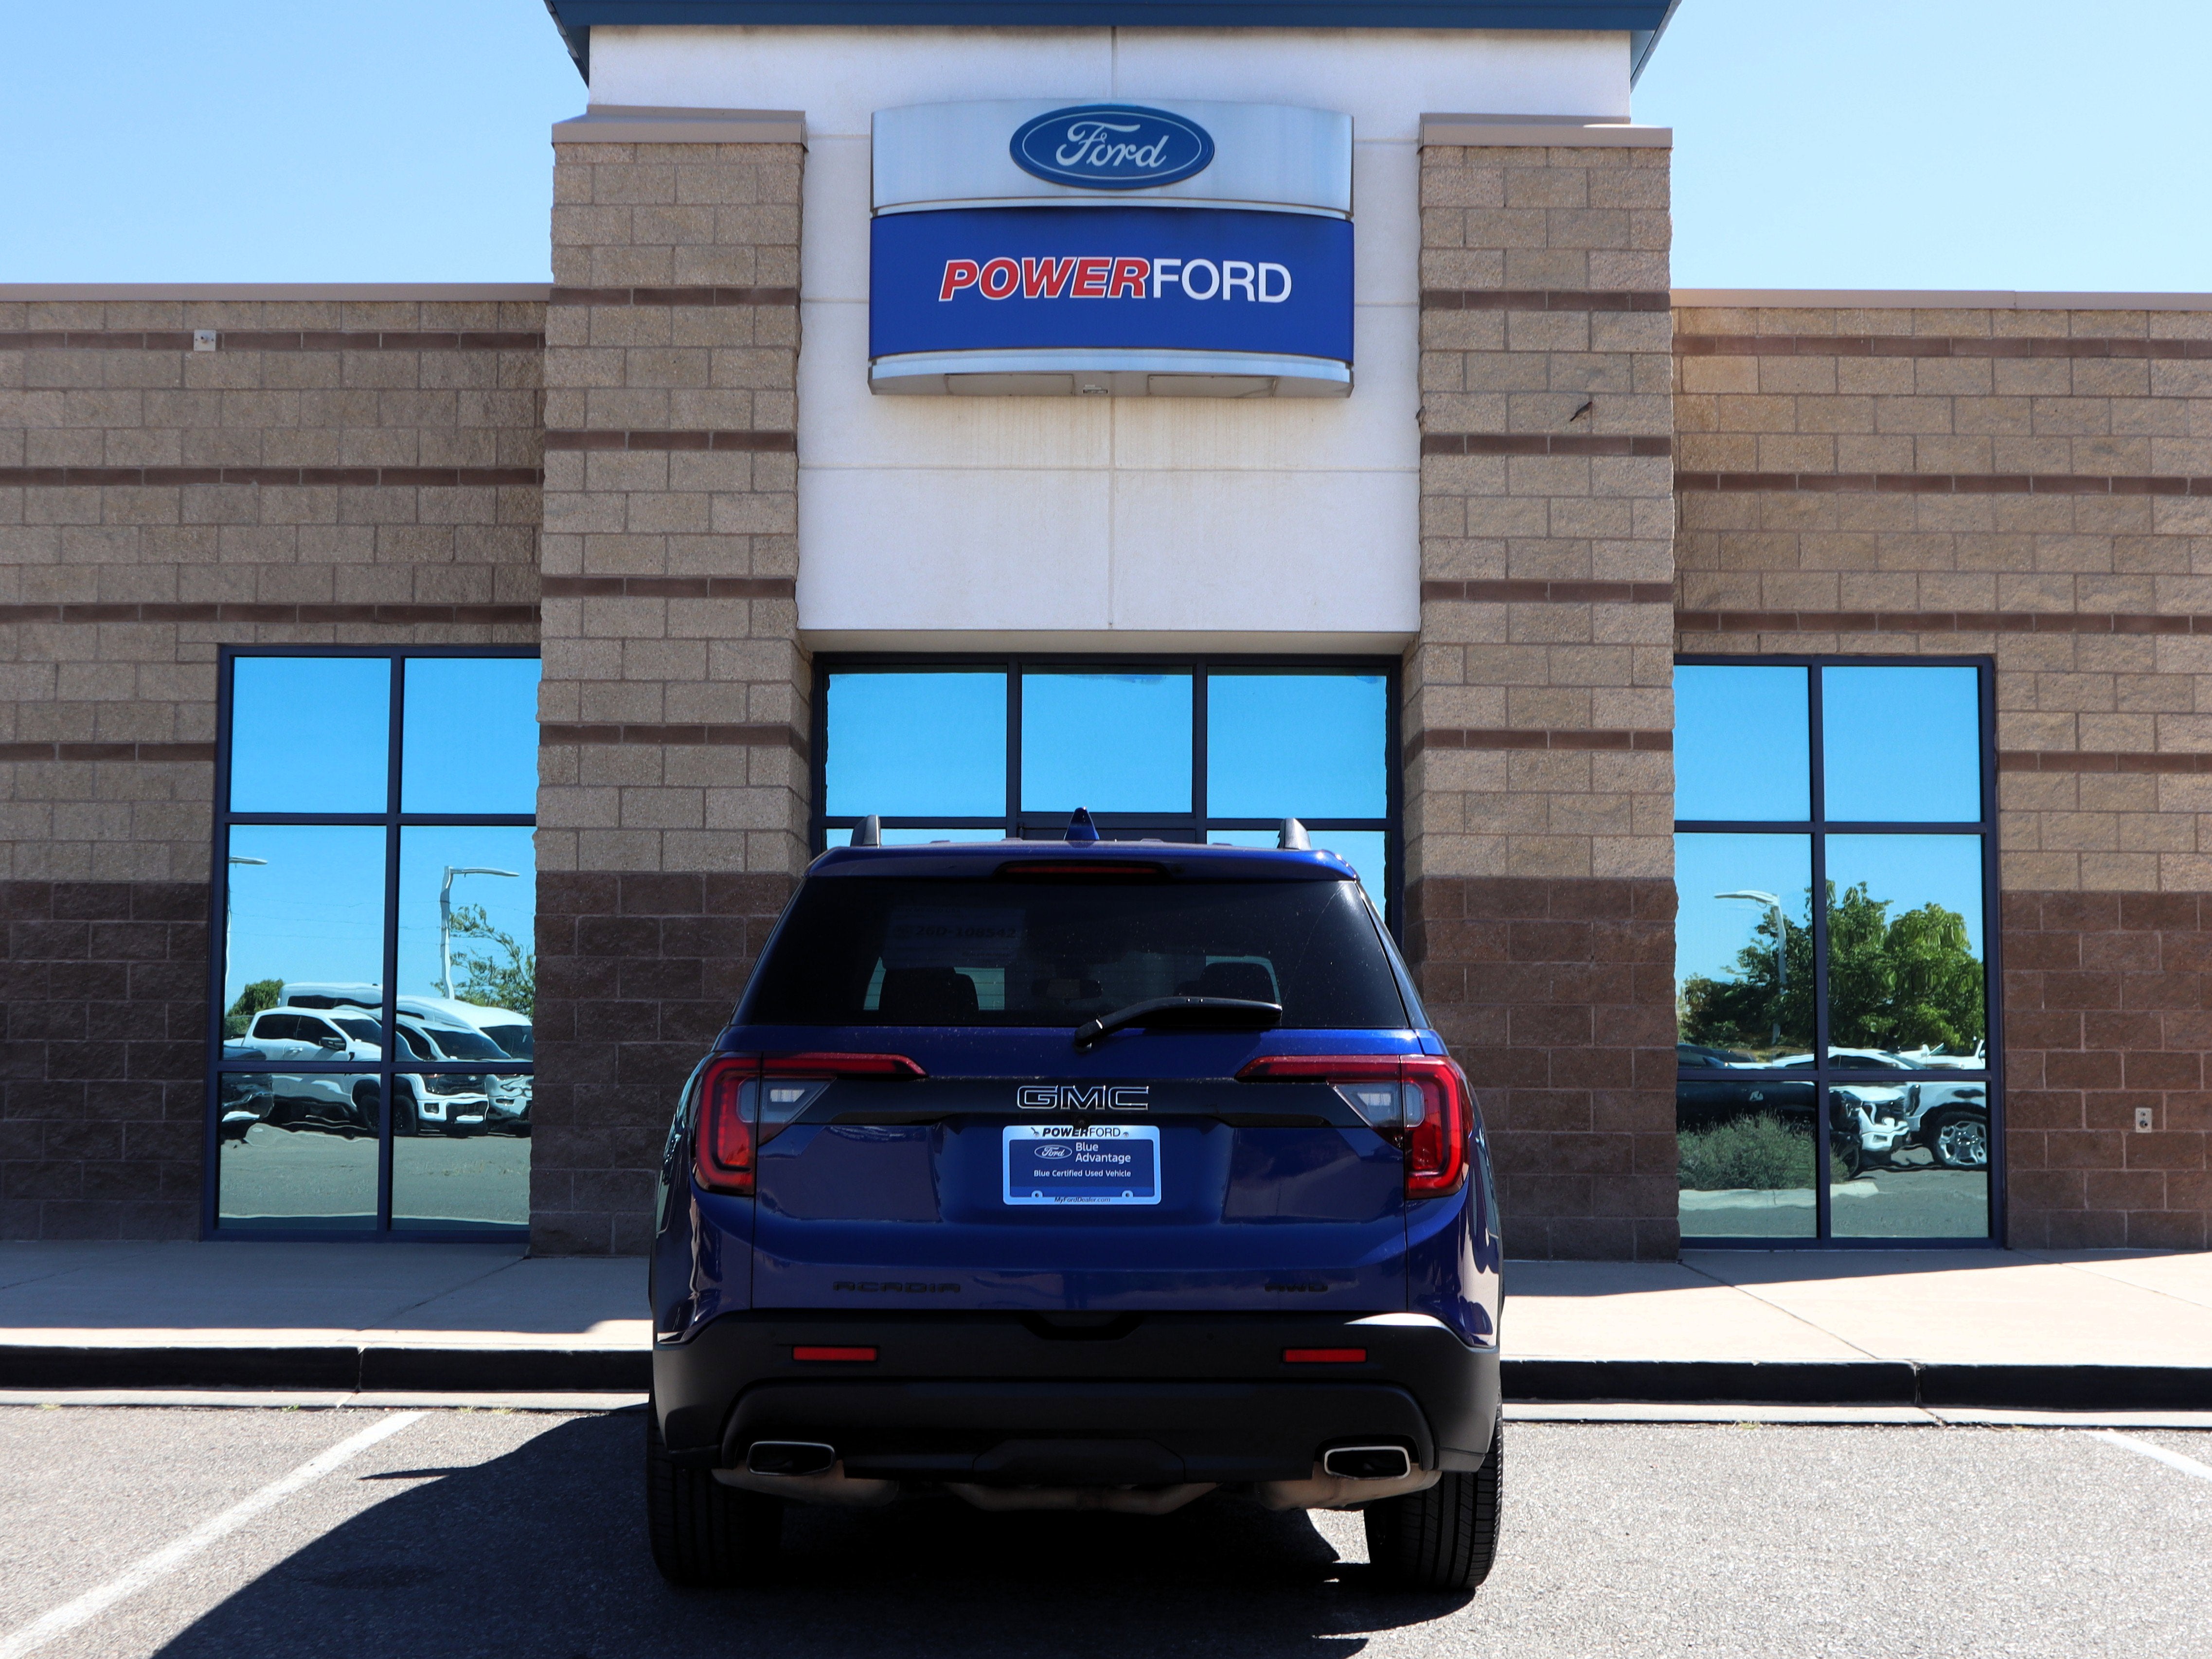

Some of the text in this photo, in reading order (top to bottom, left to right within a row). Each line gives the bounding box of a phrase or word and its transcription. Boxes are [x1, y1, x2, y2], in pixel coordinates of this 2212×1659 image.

[1055, 121, 1169, 169] Ford
[939, 256, 1292, 303] POWERFORD
[1017, 1085, 1149, 1110] GMC
[1042, 1146, 1065, 1157] Ford
[1075, 1142, 1099, 1152] Blue
[1075, 1153, 1131, 1164] Advantage
[833, 1281, 961, 1293] ACADIA
[1265, 1282, 1329, 1292] AWD
